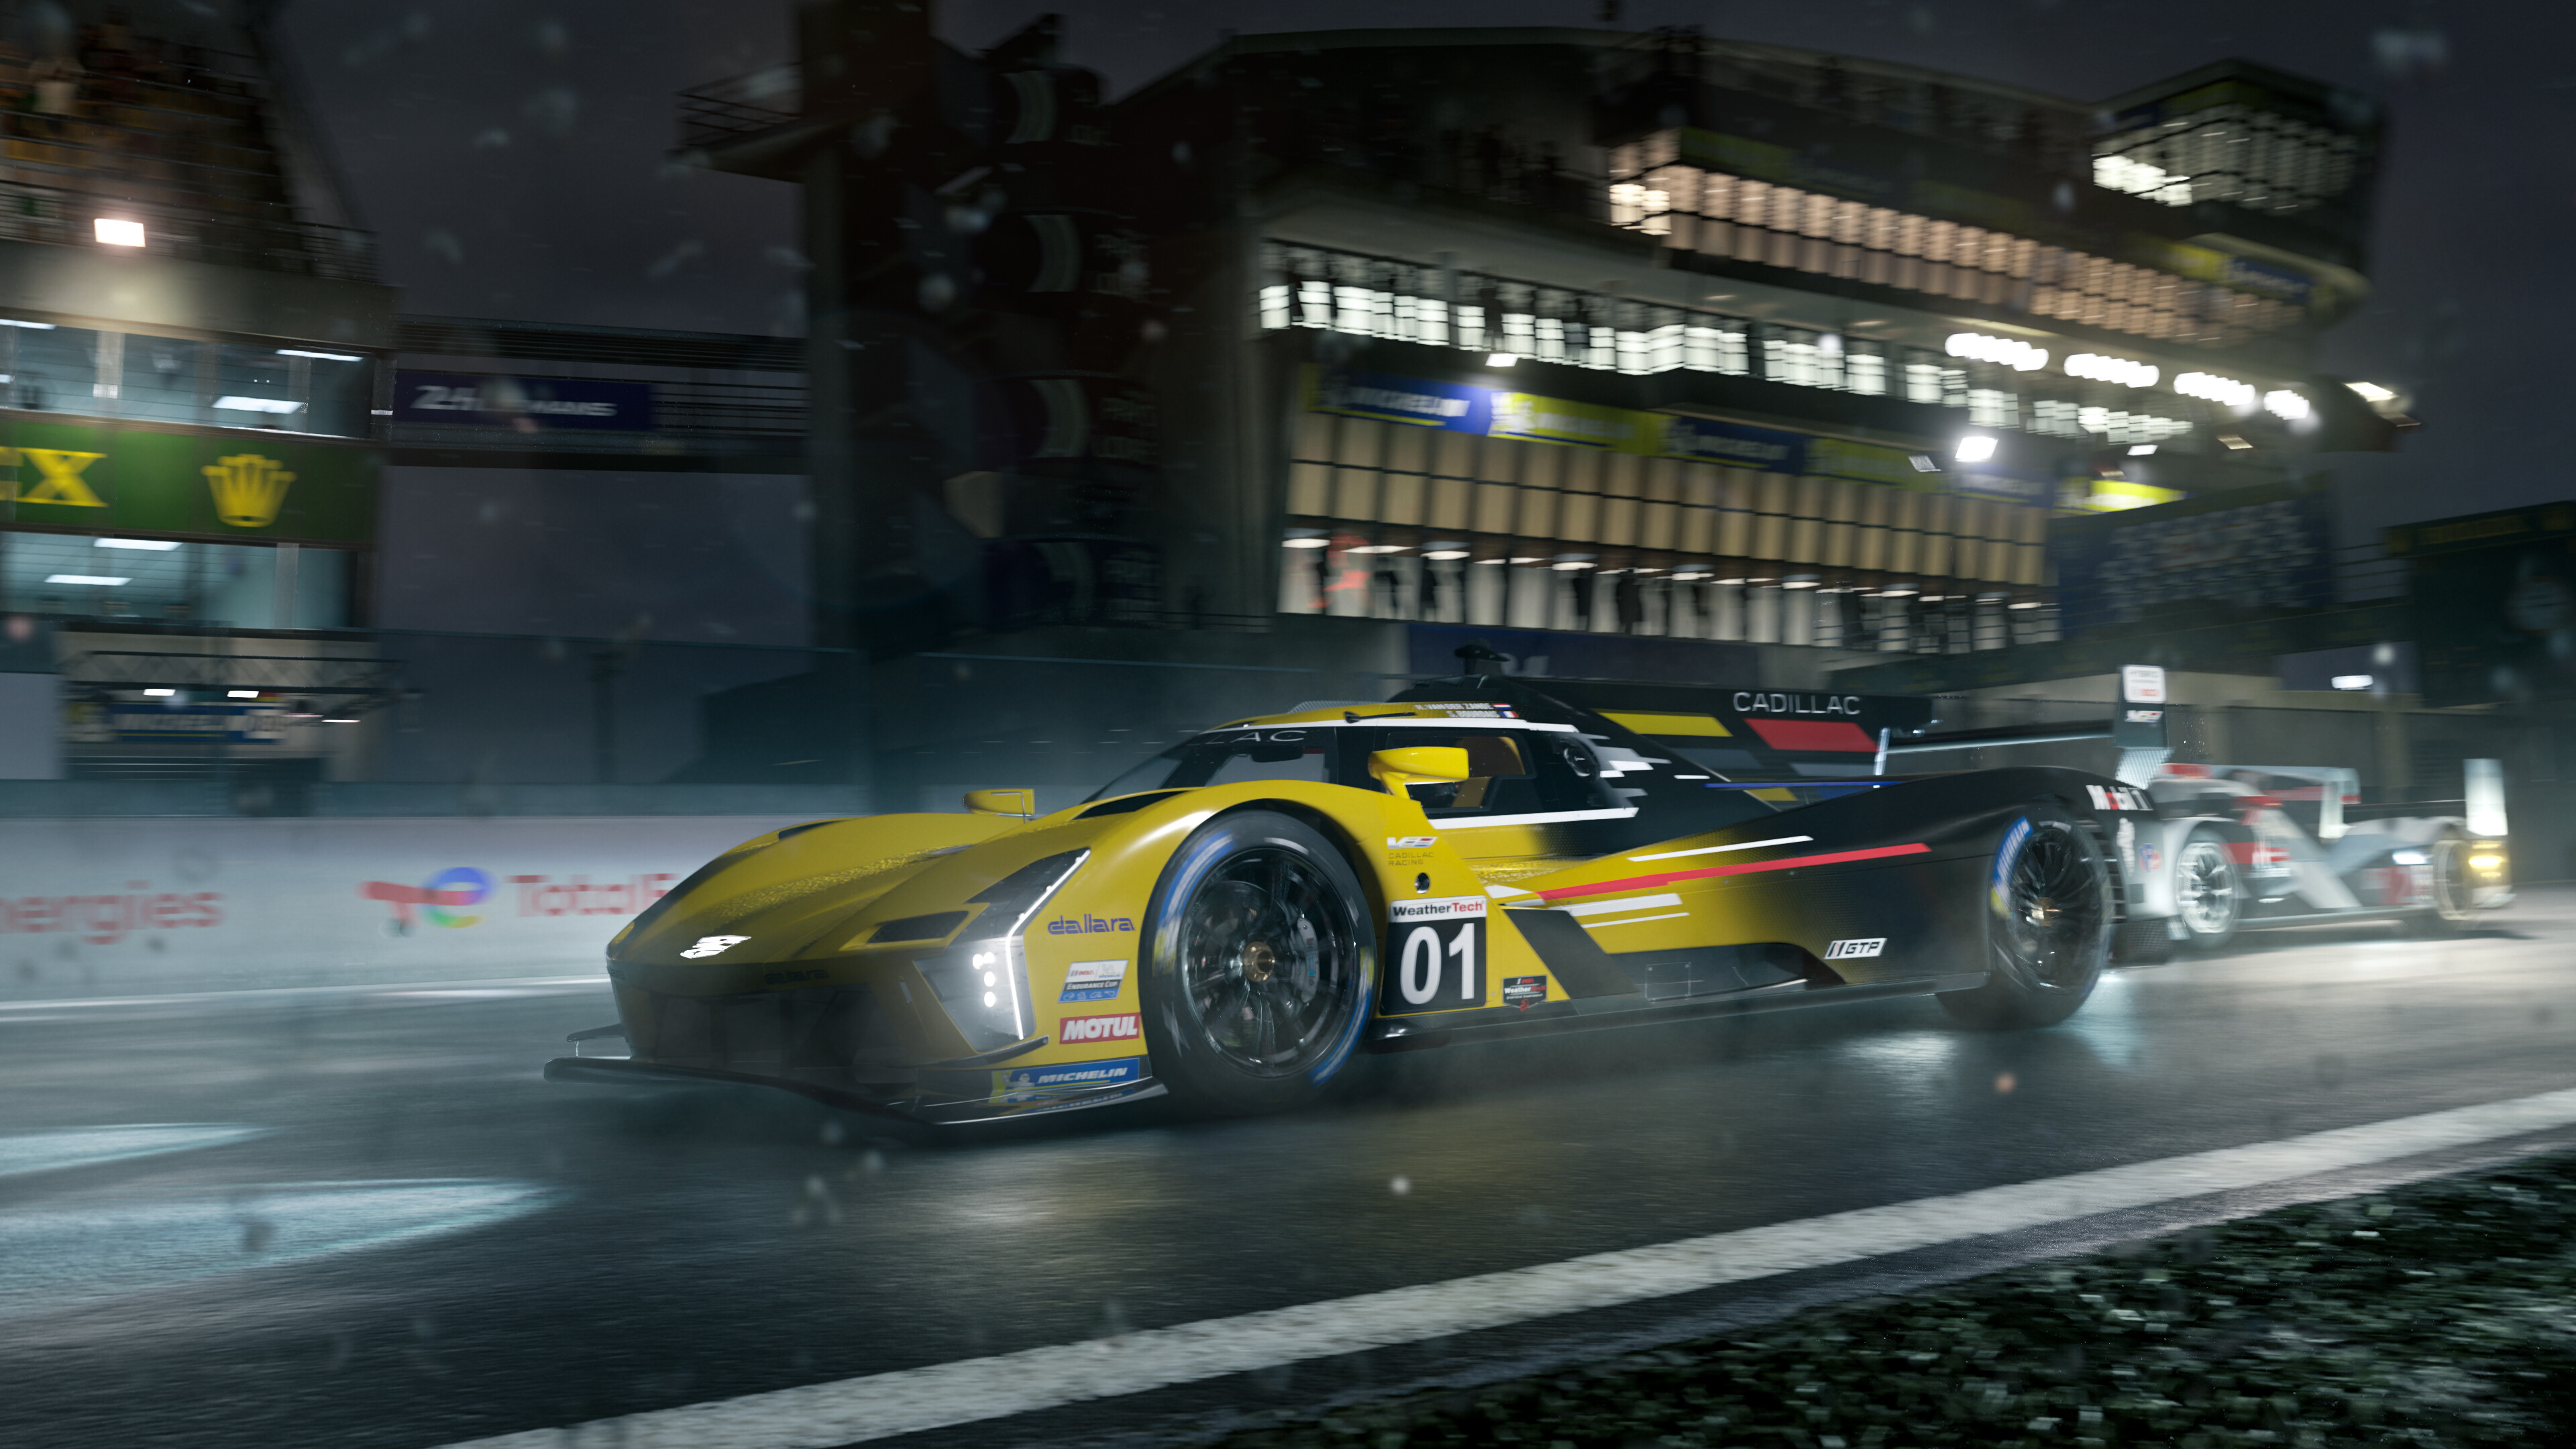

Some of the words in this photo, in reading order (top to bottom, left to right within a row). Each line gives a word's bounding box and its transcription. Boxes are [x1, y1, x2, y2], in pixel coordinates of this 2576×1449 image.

[1733, 692, 1861, 715] CADILLAC
[1393, 901, 1484, 916] WeatherTech
[1048, 914, 1135, 934] dallara
[1845, 942, 1880, 954] GTP
[1400, 922, 1474, 1004] 01
[1062, 1016, 1138, 1041] MOTUL
[1038, 1067, 1128, 1084] MICHELIN
